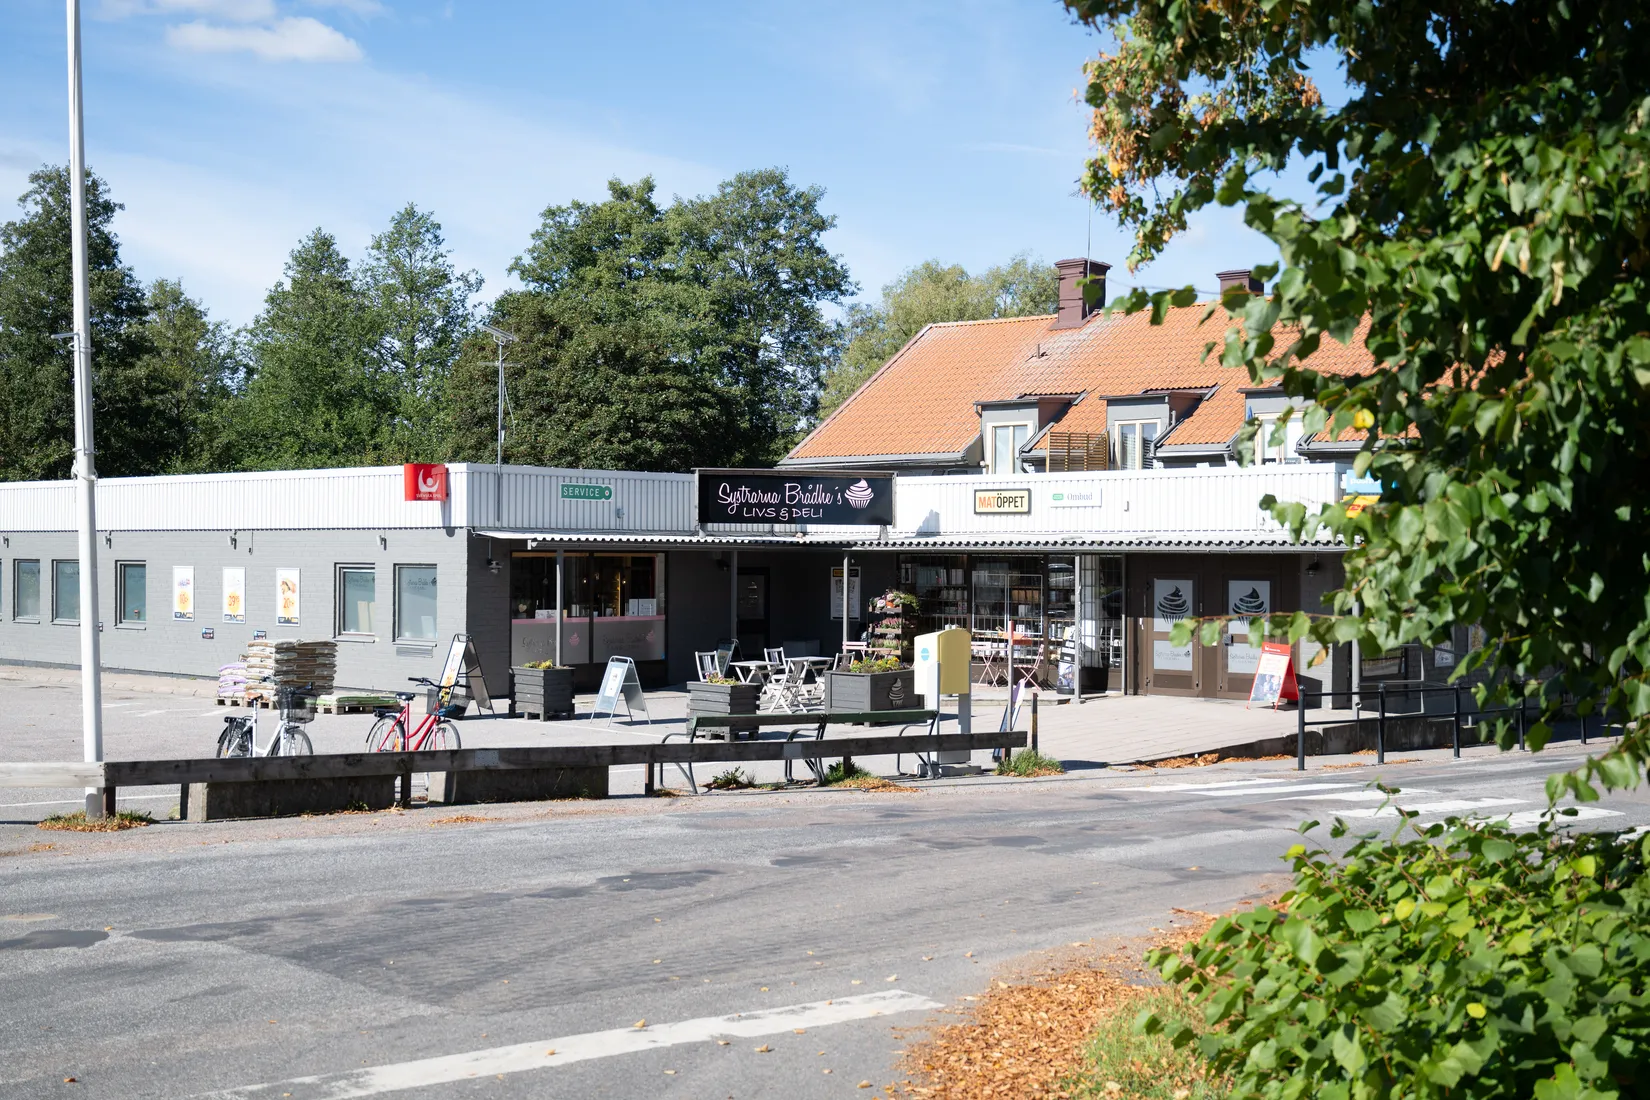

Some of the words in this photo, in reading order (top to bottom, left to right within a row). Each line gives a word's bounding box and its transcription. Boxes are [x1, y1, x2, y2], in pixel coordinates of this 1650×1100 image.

[563, 486, 600, 497] SERVICE
[717, 482, 782, 515] Systrarna
[1066, 492, 1093, 501] Ombud
[978, 492, 1025, 509] MATÖPPET
[743, 508, 776, 518] LIVS
[779, 507, 789, 521] &
[792, 508, 823, 518] DELI
